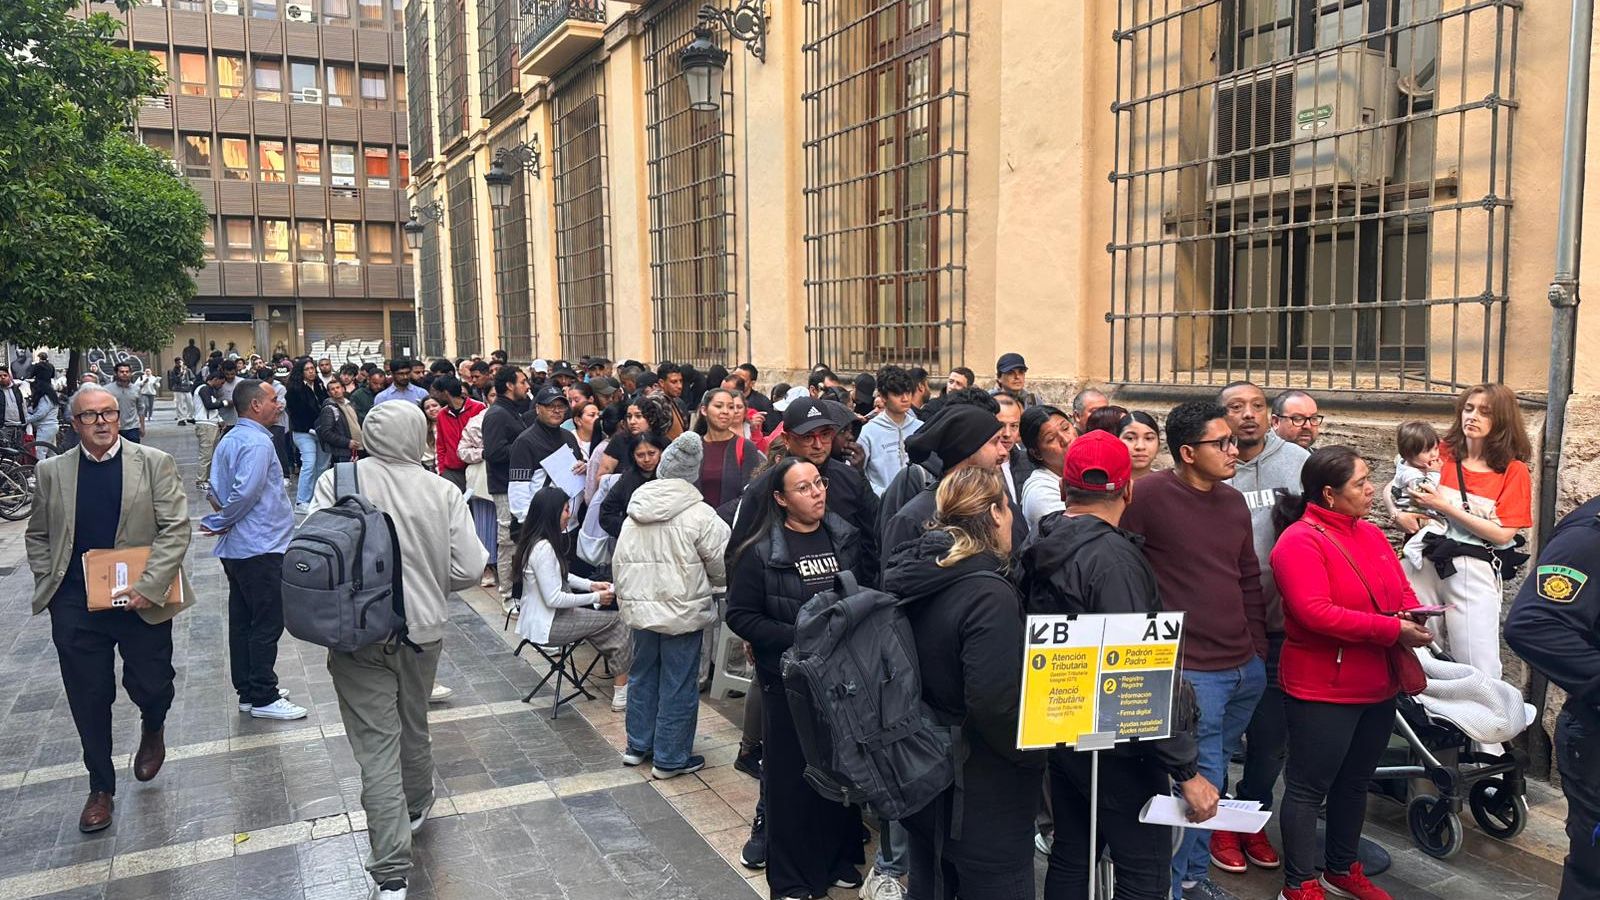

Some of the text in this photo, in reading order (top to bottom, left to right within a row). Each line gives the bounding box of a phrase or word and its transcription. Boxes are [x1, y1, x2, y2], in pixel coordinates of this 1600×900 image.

[1052, 622, 1069, 644] B
[1142, 620, 1159, 641] A
[1051, 652, 1086, 662] Atención
[1125, 648, 1153, 657] Padrón
[1051, 661, 1088, 671] Tributaria
[1048, 684, 1080, 695] Atenció
